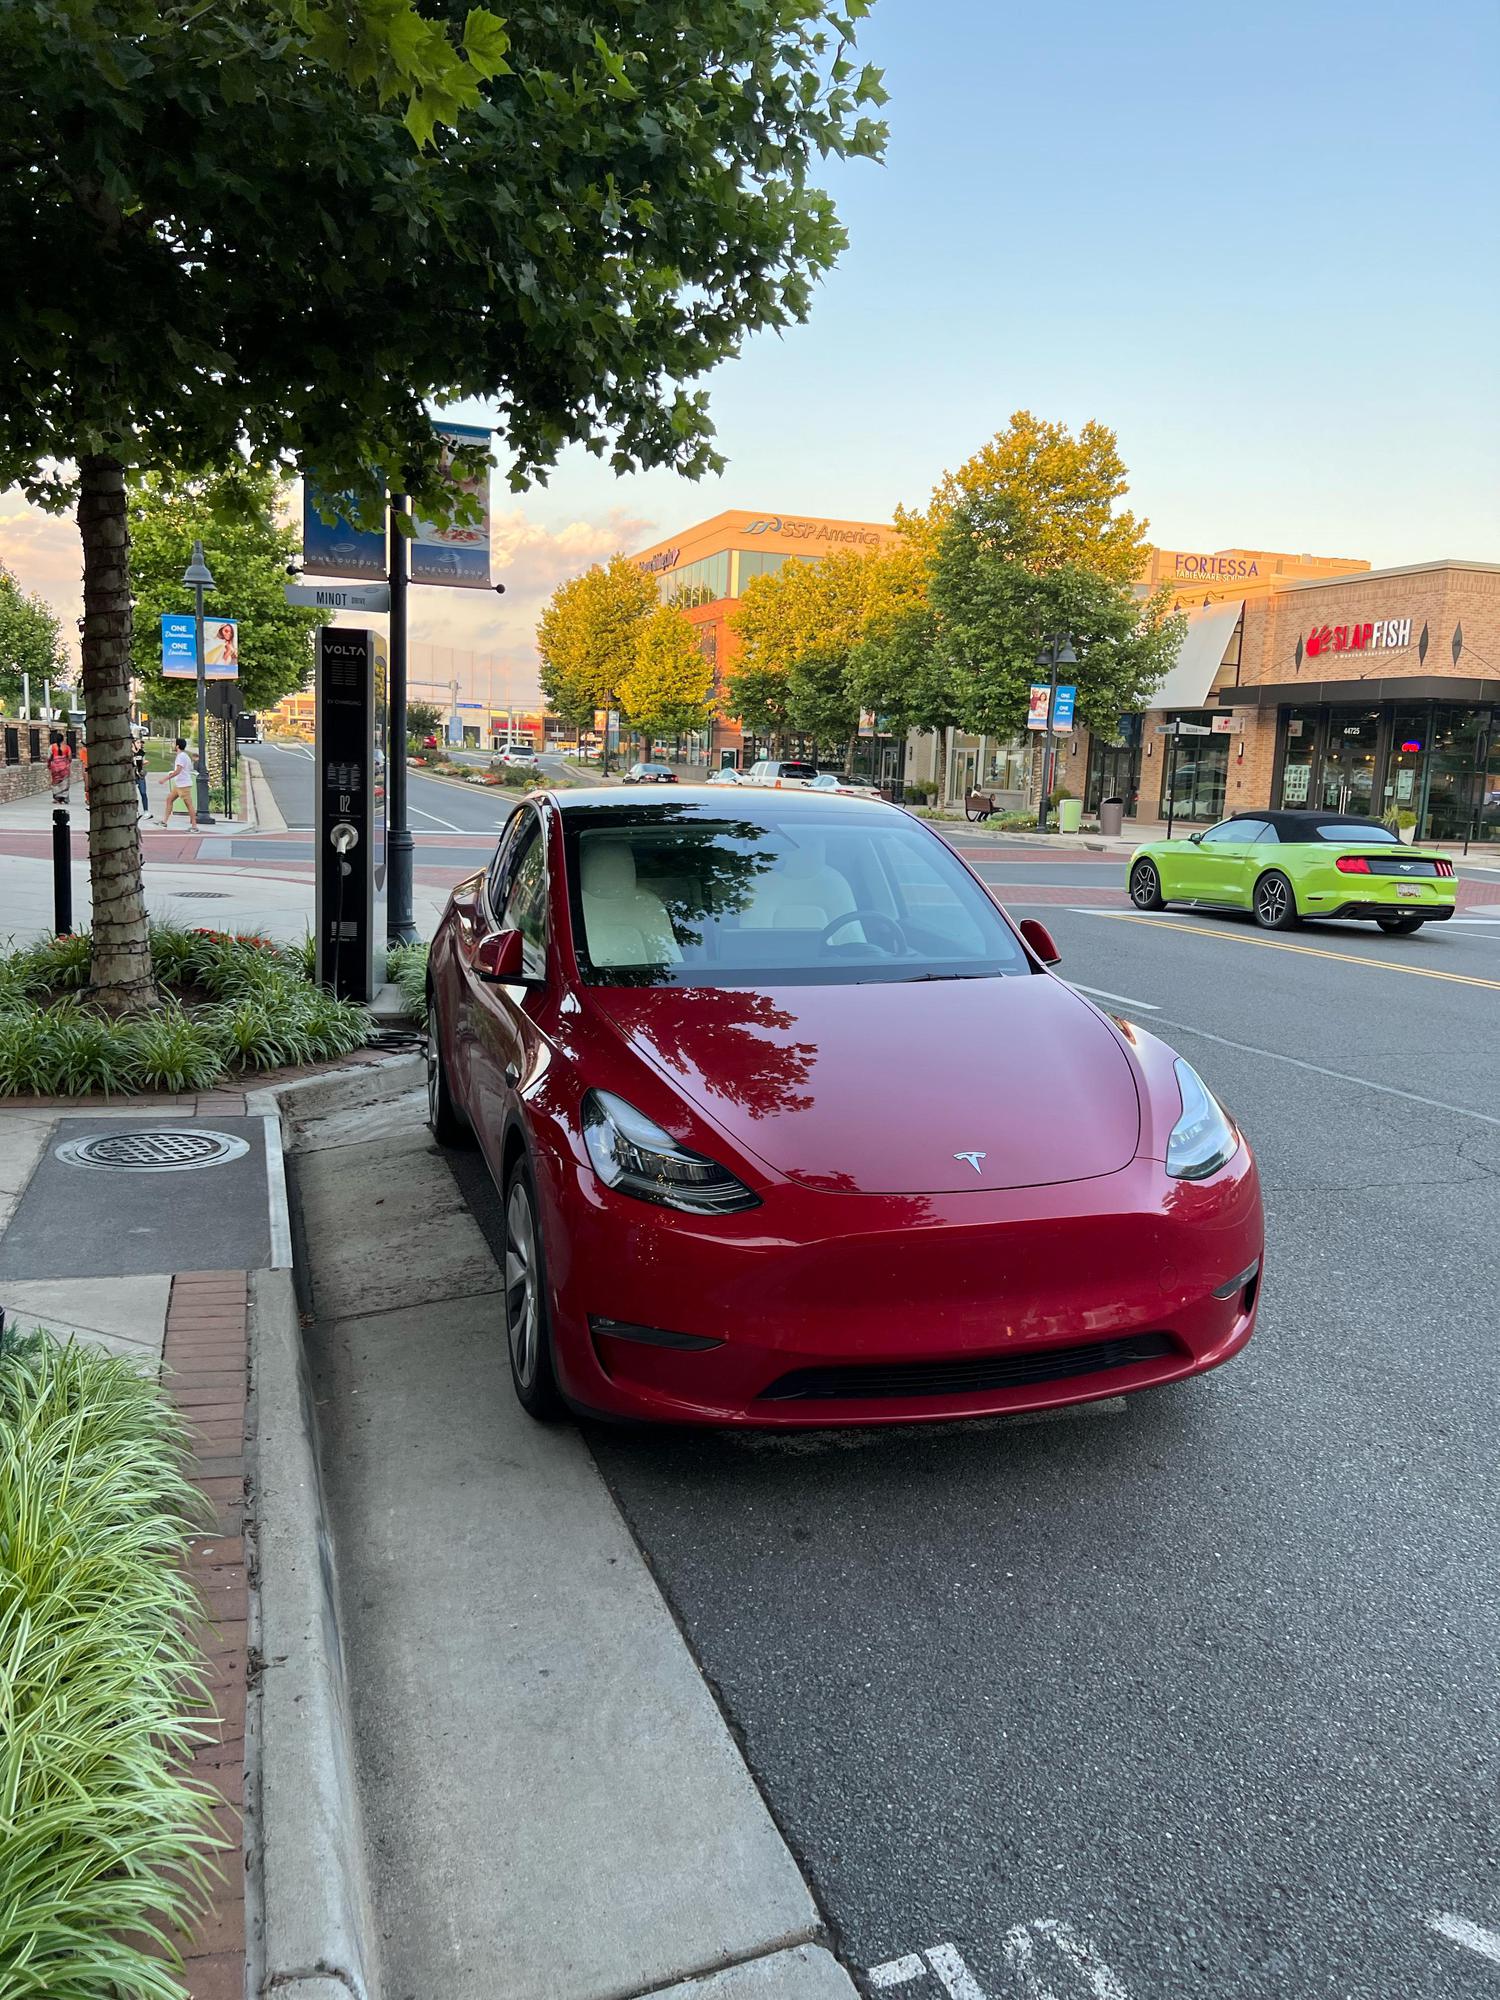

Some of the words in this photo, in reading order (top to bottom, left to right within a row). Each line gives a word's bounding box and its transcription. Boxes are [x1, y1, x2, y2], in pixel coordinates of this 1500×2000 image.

[781, 522, 816, 538] SSP
[817, 524, 881, 544] America
[1175, 554, 1259, 577] FORTESSA
[1175, 569, 1220, 581] TABLEWARE
[316, 591, 347, 606] MINOT
[170, 624, 187, 632] ONE
[1332, 618, 1412, 653] SLAPFISH
[171, 642, 188, 650] ONE
[324, 645, 366, 656] VOLTA
[1344, 727, 1361, 735] 44725
[340, 795, 351, 813] 02
